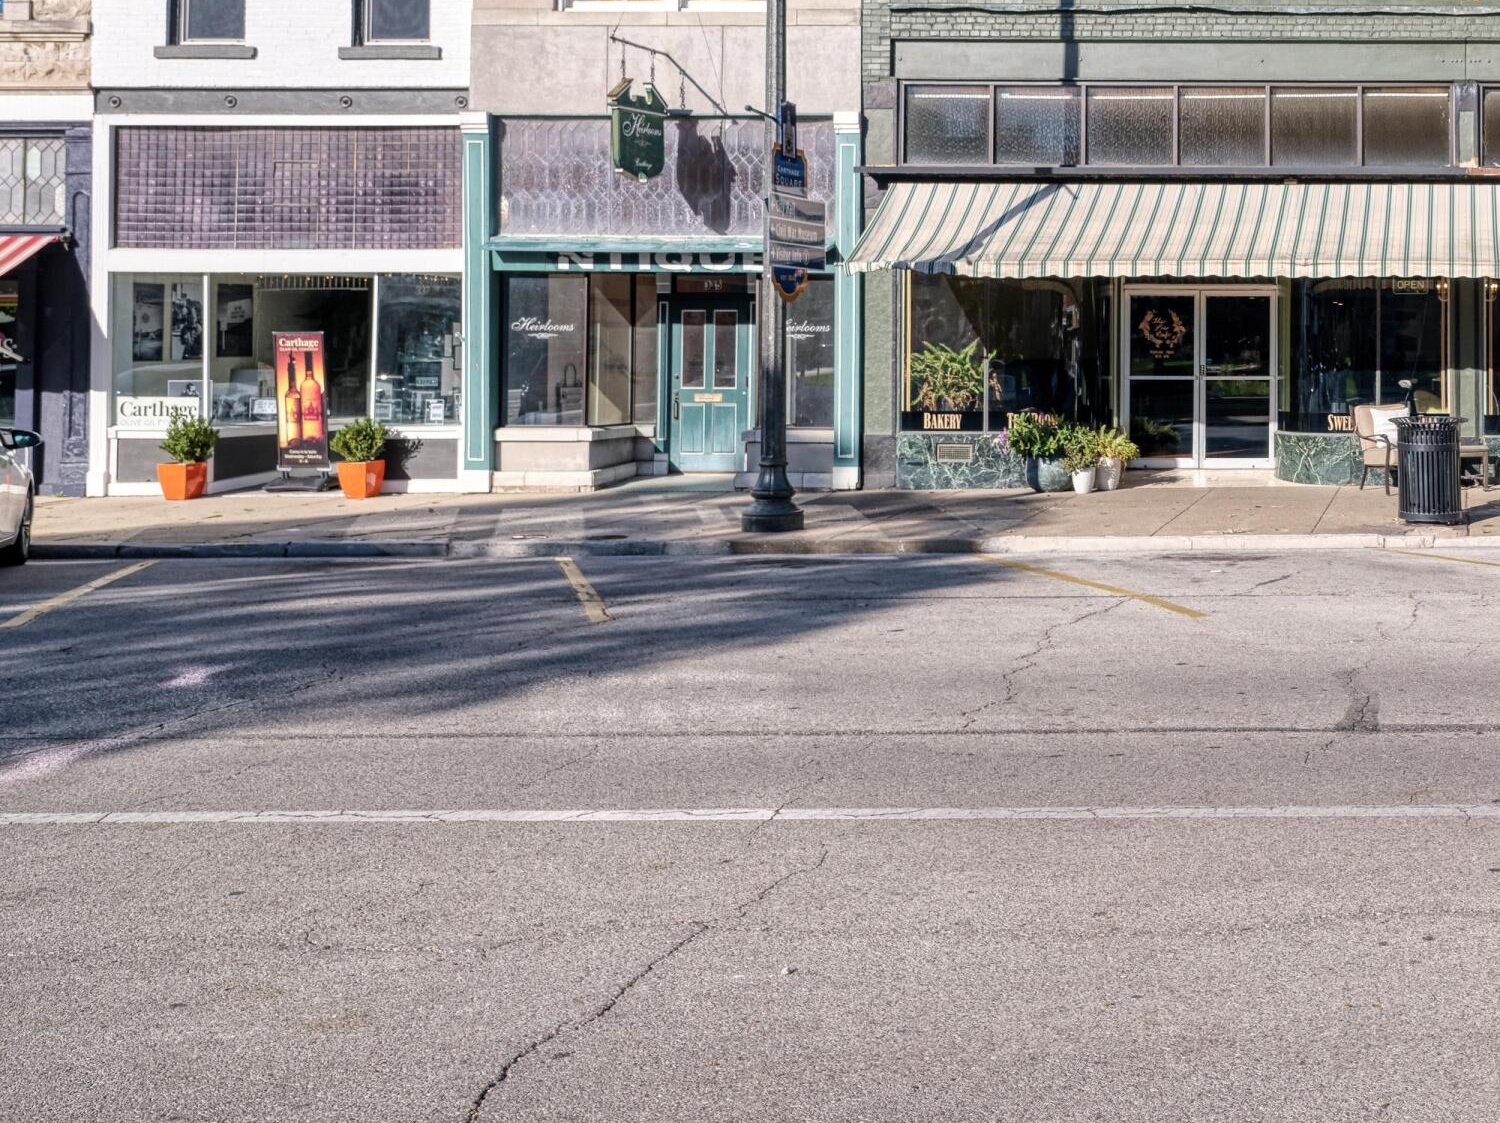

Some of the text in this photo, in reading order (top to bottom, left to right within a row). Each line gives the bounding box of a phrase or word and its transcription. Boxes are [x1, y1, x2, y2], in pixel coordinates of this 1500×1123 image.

[622, 112, 662, 137] Heirlooms
[777, 165, 801, 177] CARTHAGE
[775, 173, 803, 188] SQUARE
[558, 252, 764, 272] NTIQUE
[1397, 280, 1424, 289] OPEN
[511, 317, 575, 332] Heirlooms
[786, 318, 831, 332] eirlooms
[279, 337, 319, 347] Carthage
[120, 401, 197, 418] Carthage
[923, 412, 962, 430] BAKERY
